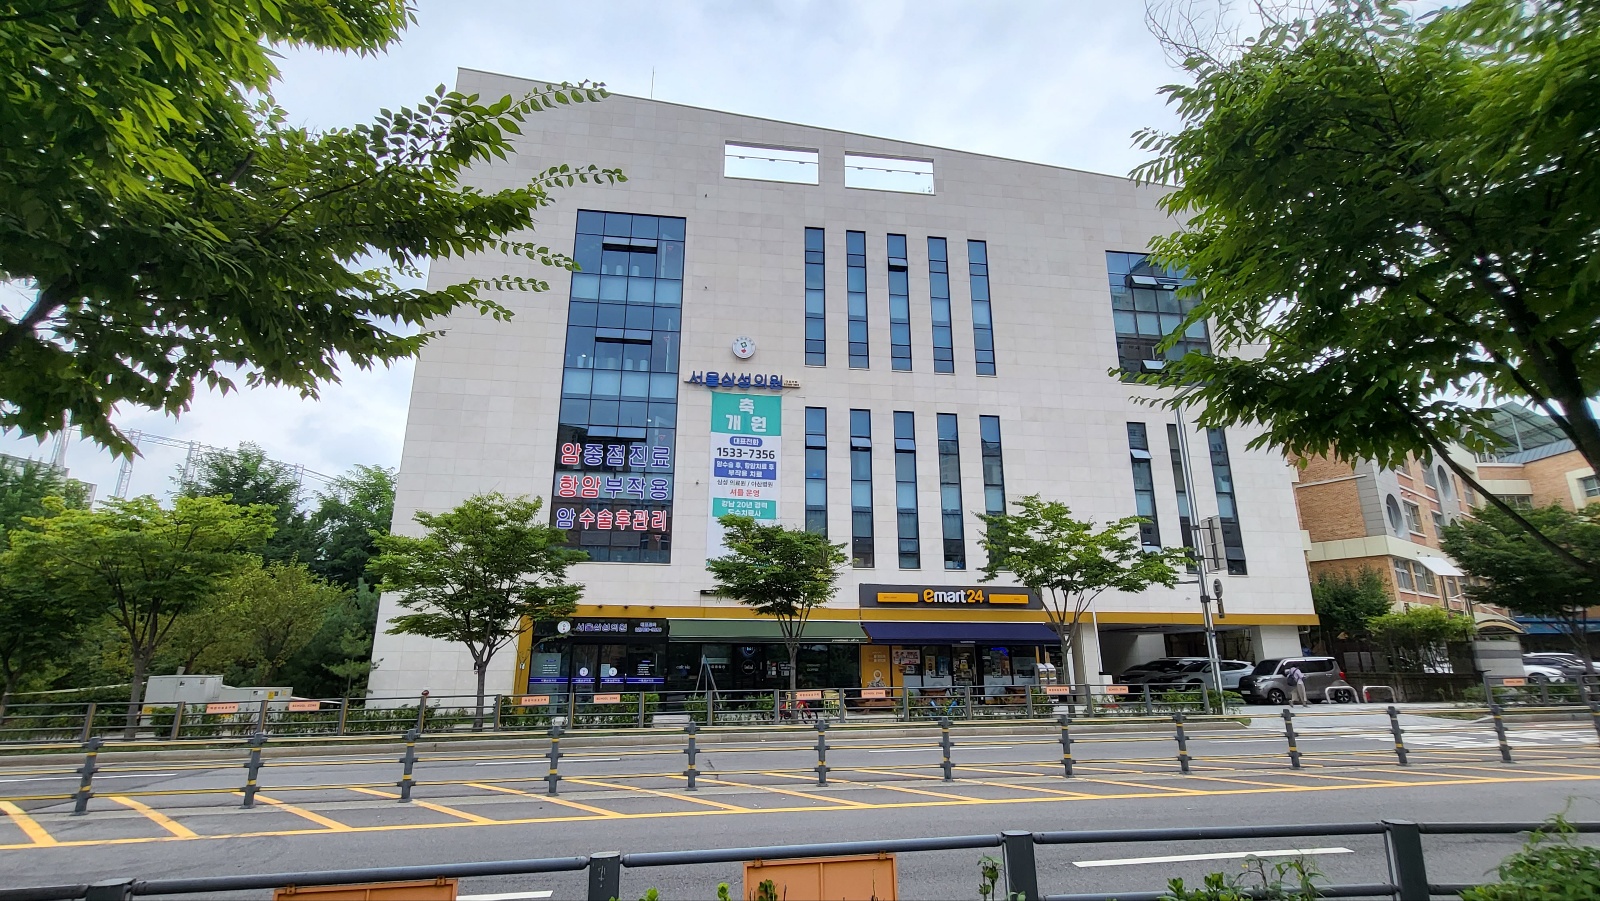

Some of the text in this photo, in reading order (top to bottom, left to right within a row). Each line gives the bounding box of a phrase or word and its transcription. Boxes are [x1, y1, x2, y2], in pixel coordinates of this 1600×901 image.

[689, 371, 783, 390] 서울삼성의원
[739, 398, 754, 414] 축
[733, 438, 759, 446] 대표전화
[561, 442, 670, 468] 암중점진료
[716, 447, 775, 459] 1533-7356
[559, 475, 668, 500] 항암부작용
[923, 589, 985, 603] emart24
